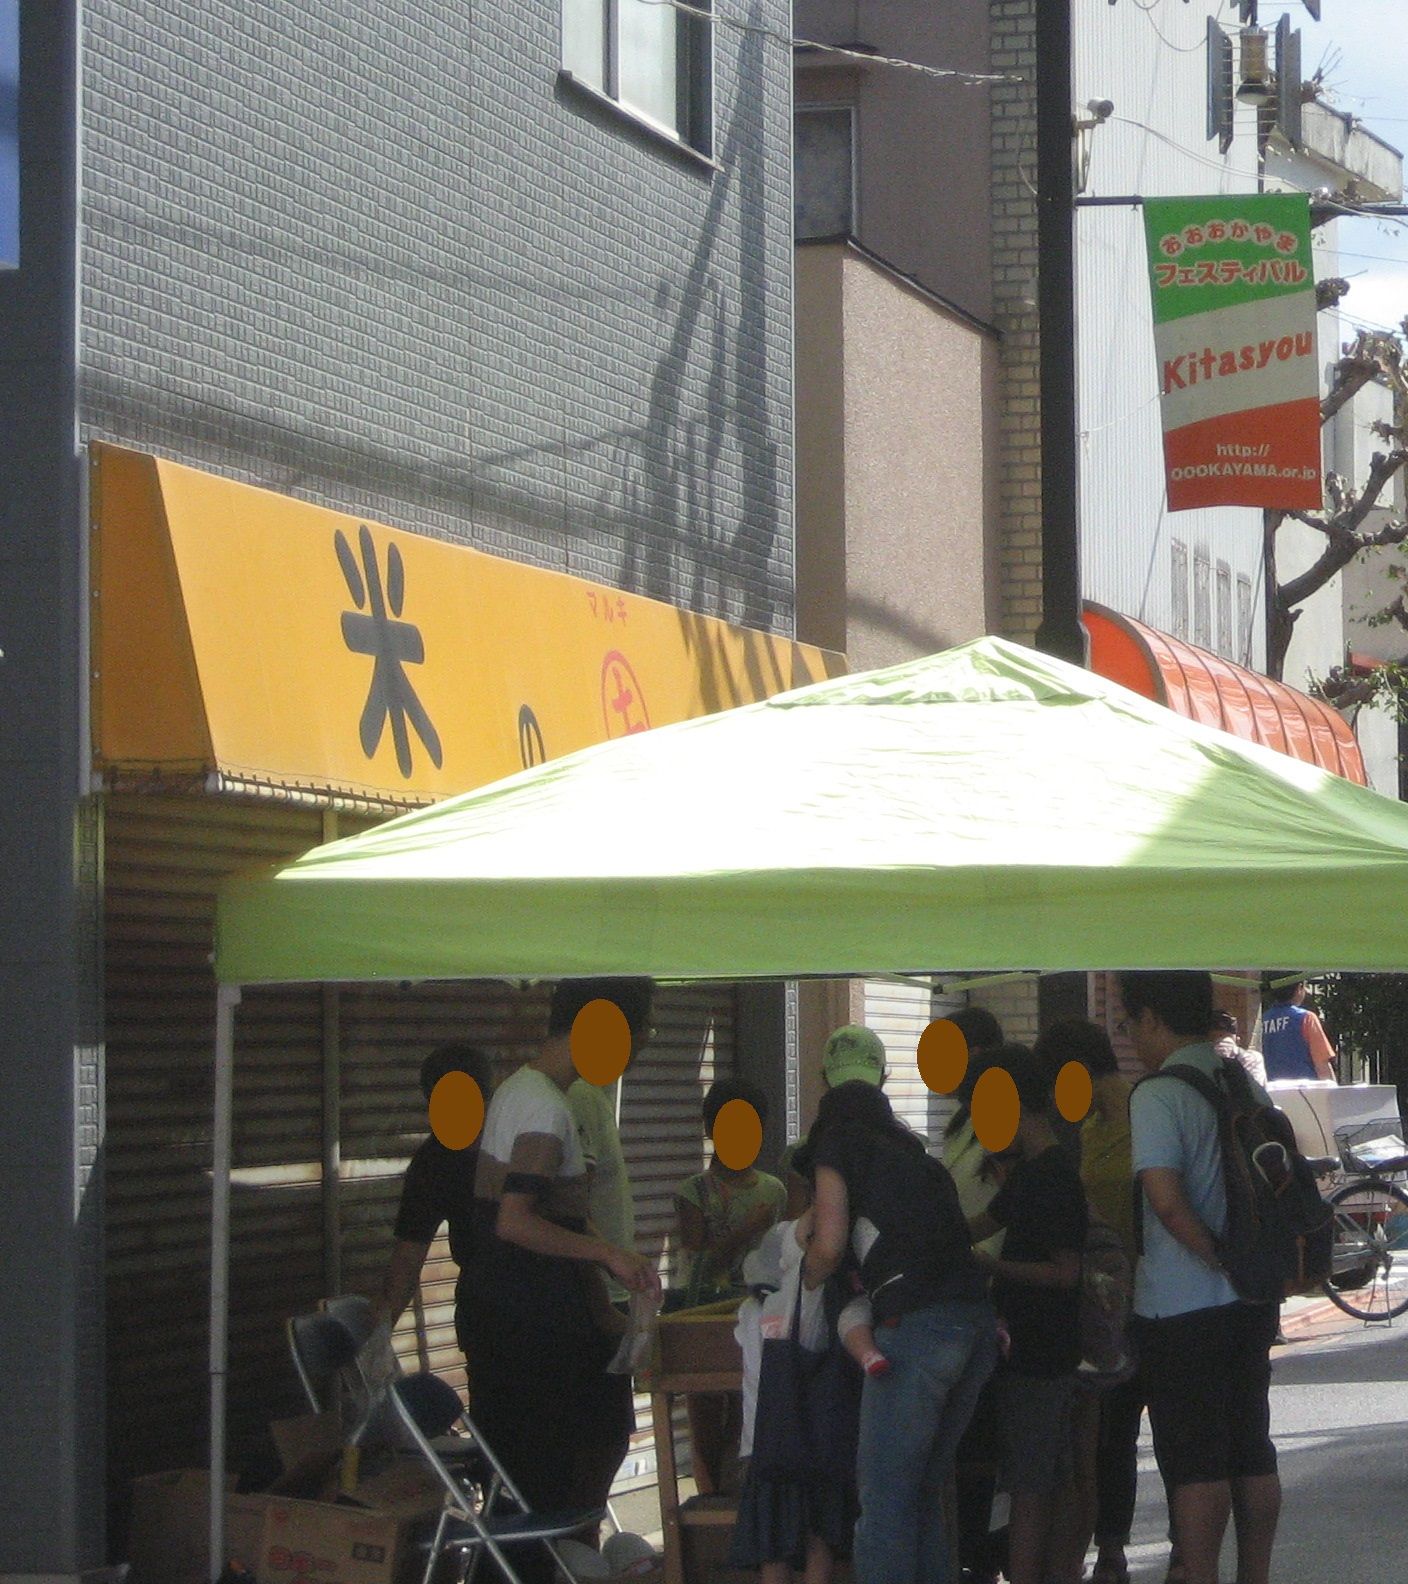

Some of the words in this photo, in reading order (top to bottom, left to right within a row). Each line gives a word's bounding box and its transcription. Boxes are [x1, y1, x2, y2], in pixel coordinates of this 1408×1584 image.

[1159, 219, 1298, 256] おおおかやま
[1155, 259, 1307, 288] フェスティバル
[1162, 331, 1313, 395] Kitasyou
[1216, 443, 1270, 458] http://
[587, 591, 629, 628] マルキ
[1263, 1016, 1290, 1034] TAFF
